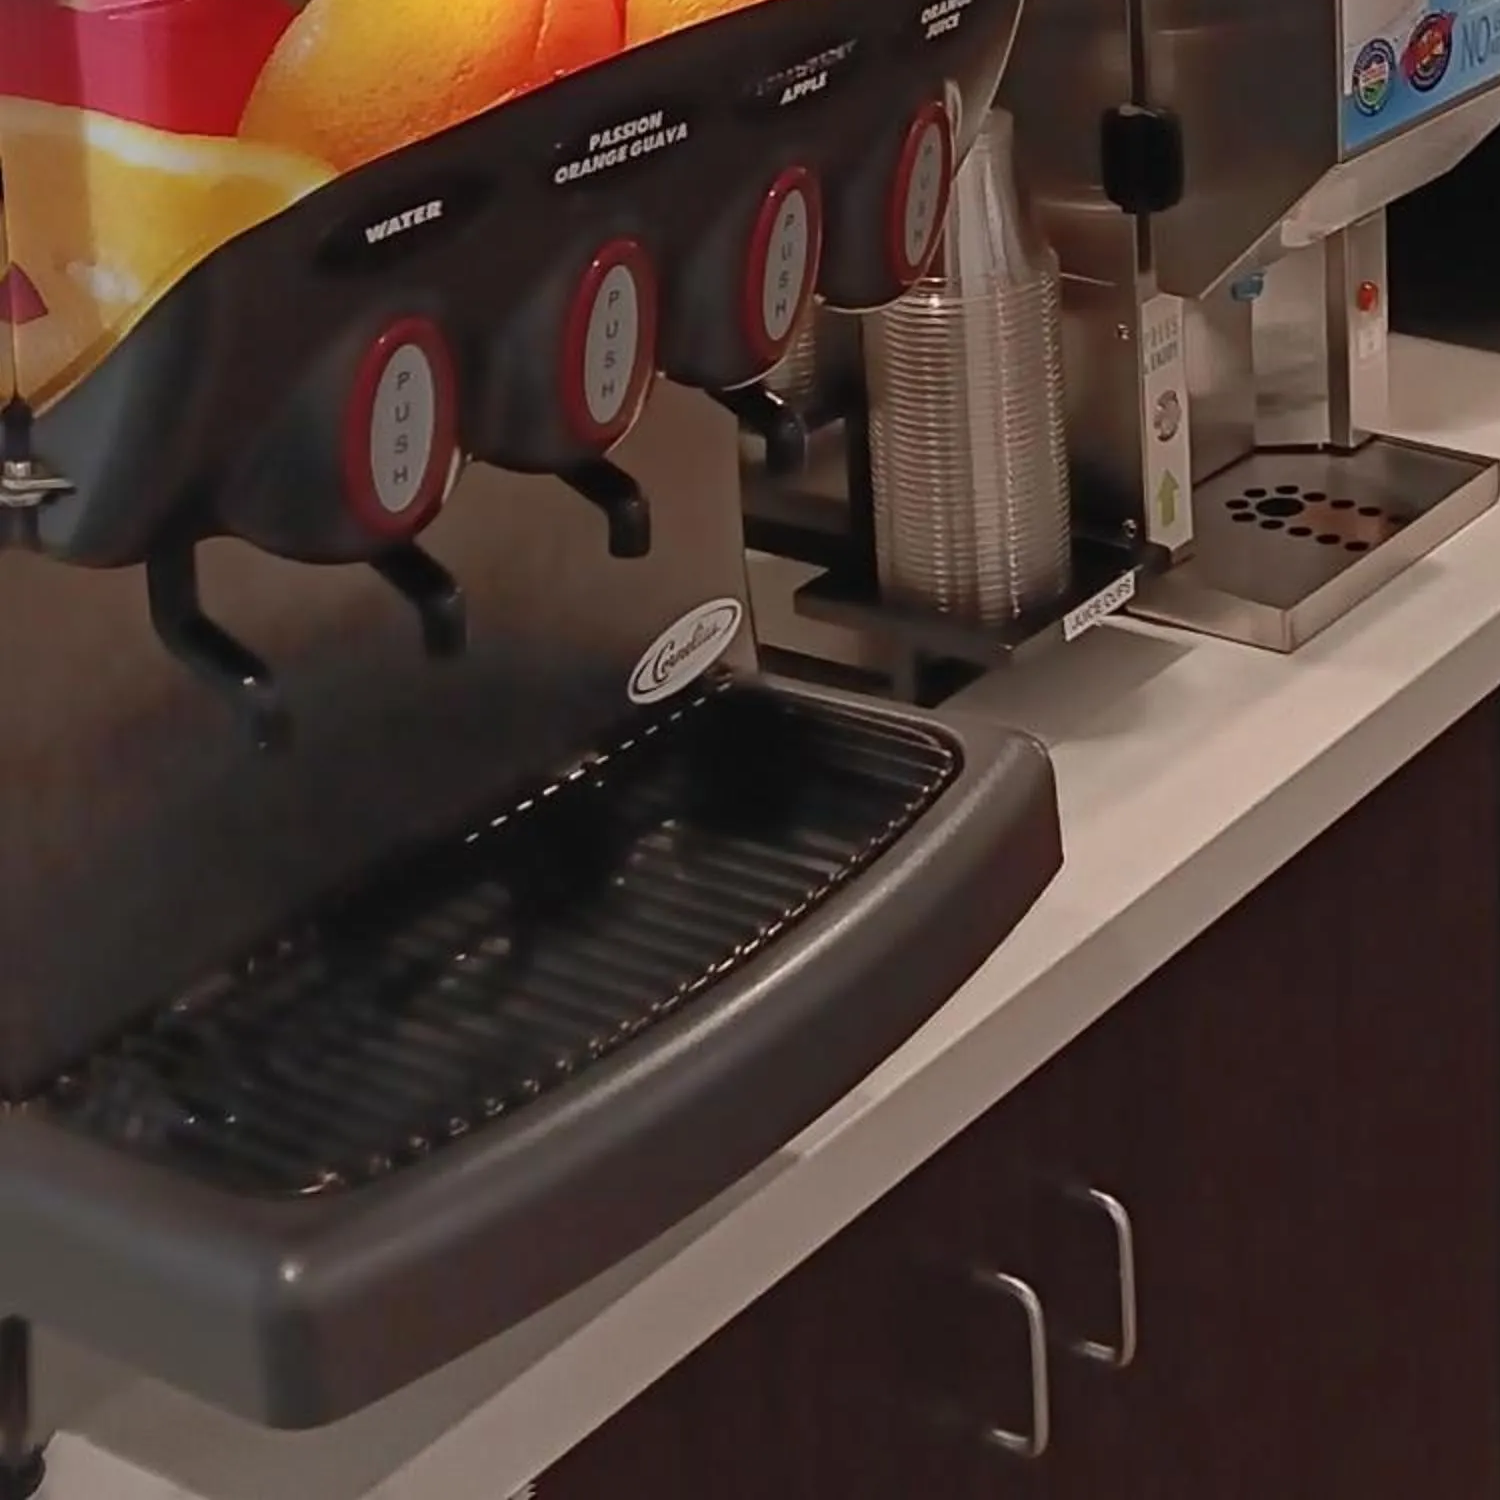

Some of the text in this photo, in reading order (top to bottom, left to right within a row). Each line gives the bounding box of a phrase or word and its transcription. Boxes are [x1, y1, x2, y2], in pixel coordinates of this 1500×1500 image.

[924, 12, 961, 40] JUICE
[1461, 15, 1491, 72] NO
[780, 71, 828, 105] APPLE
[554, 122, 688, 184] ORANGE GUAVA
[589, 110, 664, 152] PASSION
[365, 200, 443, 243] WATER
[775, 212, 795, 318] PUSH
[602, 289, 621, 399] PUSH
[393, 370, 411, 485] PUSH
